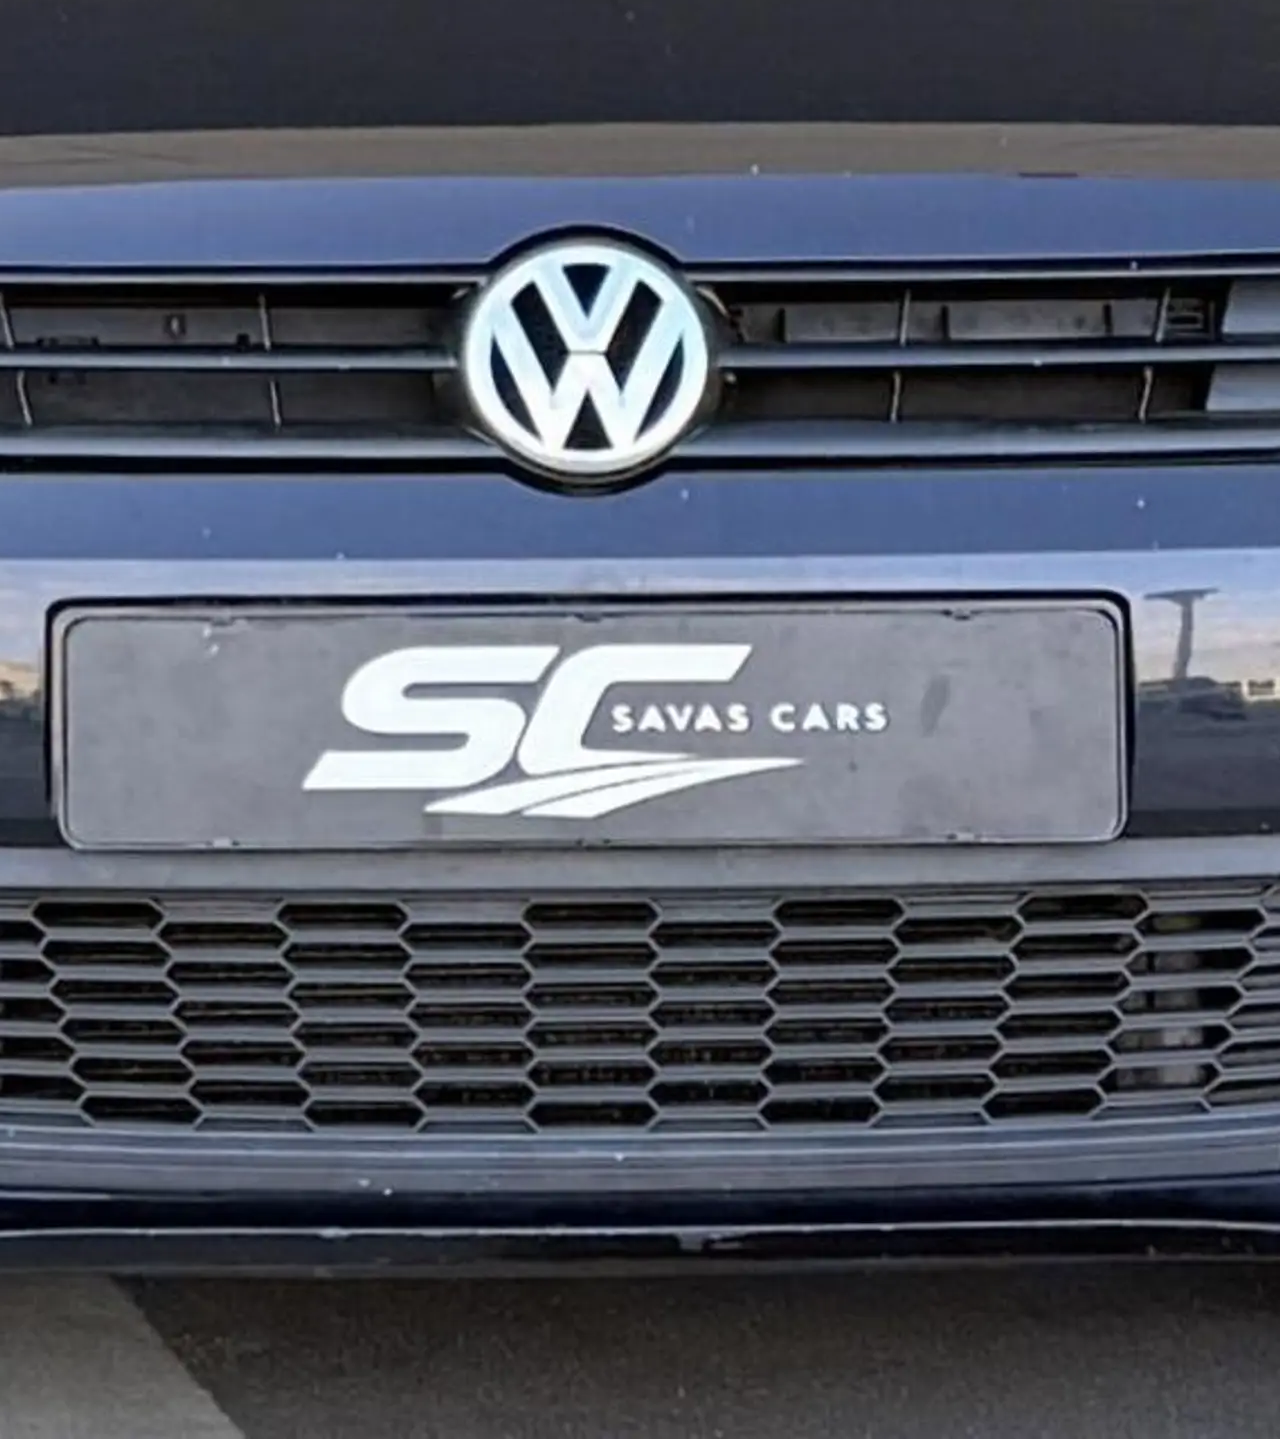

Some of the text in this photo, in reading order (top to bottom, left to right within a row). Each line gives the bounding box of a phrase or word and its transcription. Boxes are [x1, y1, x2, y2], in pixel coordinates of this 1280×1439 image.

[478, 250, 697, 465] VW
[302, 644, 752, 791] SC
[611, 701, 888, 733] SAVAS CARS
